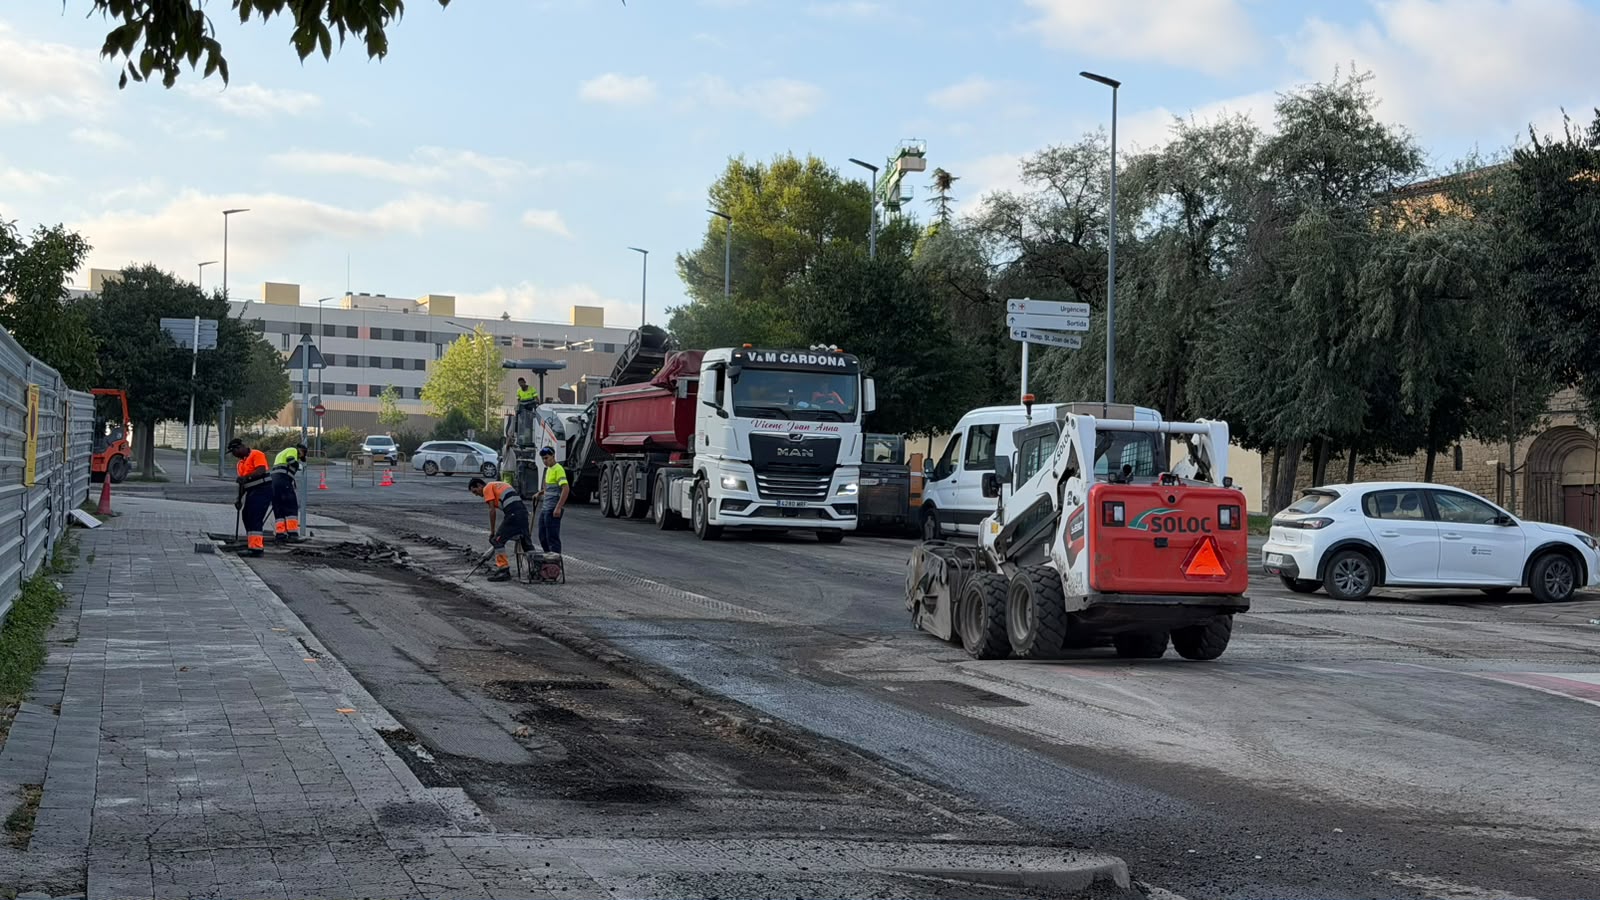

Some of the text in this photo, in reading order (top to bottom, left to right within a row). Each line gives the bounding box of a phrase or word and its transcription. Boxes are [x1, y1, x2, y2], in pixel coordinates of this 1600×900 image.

[779, 353, 846, 367] CARDONA
[814, 422, 839, 432] Anna
[777, 447, 813, 457] MAN
[1151, 516, 1212, 533] SOLOC
